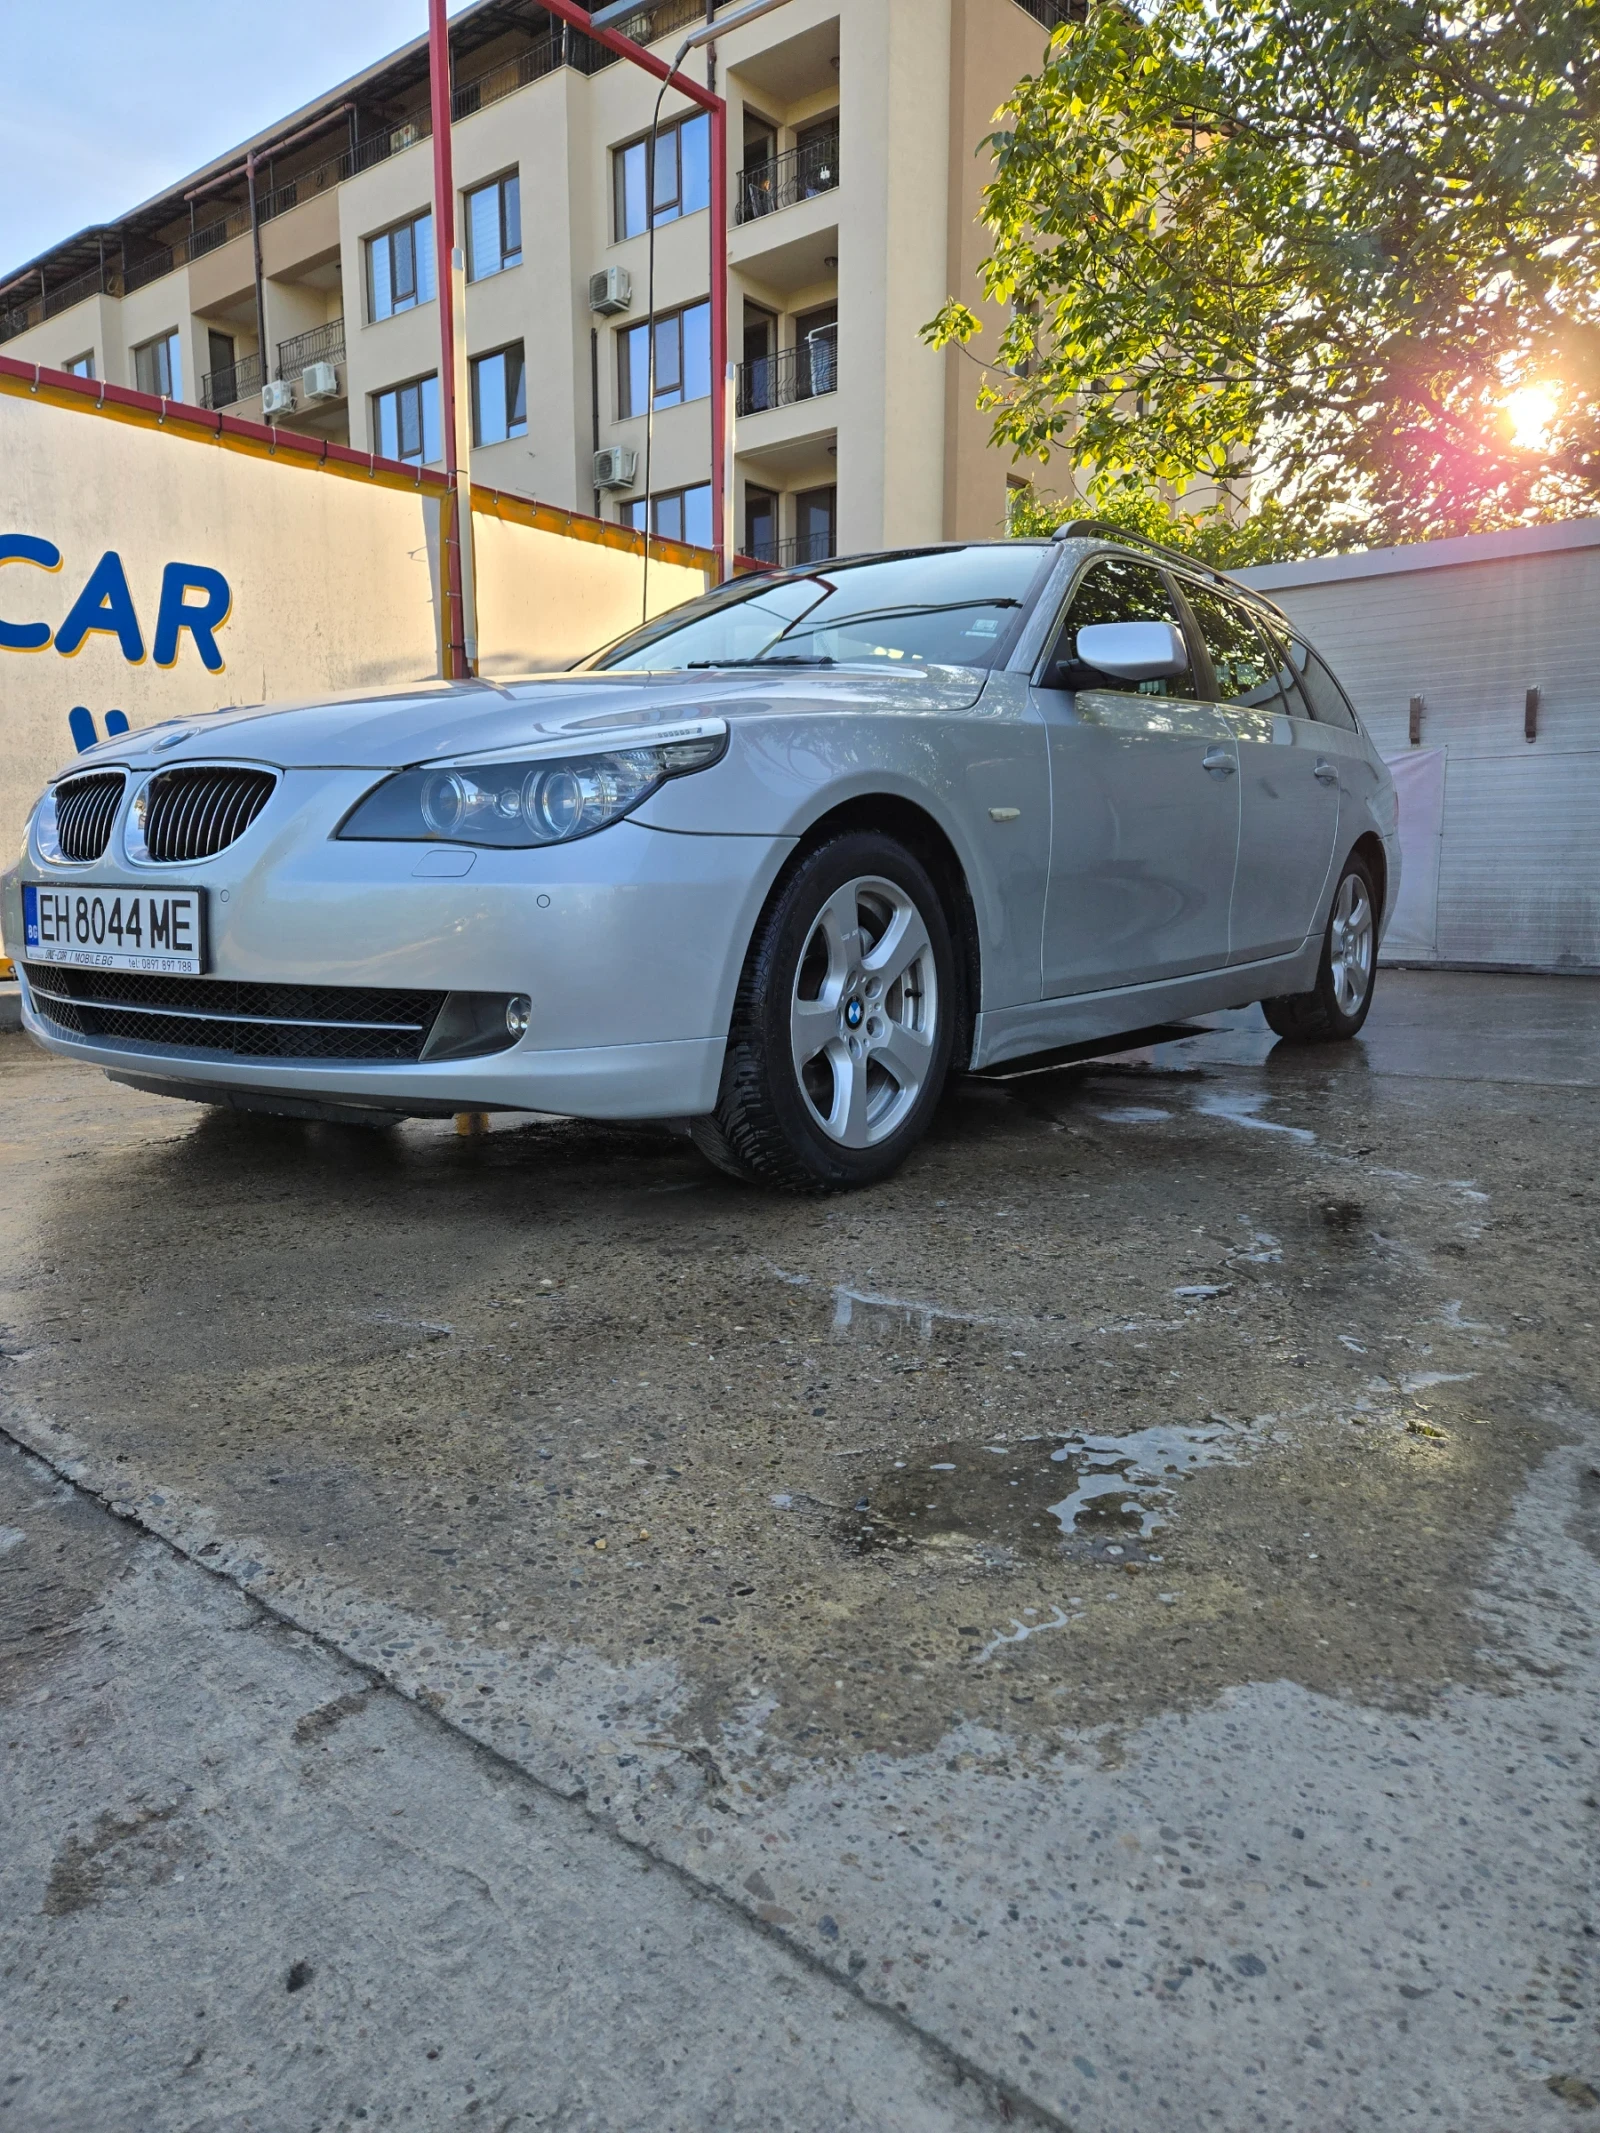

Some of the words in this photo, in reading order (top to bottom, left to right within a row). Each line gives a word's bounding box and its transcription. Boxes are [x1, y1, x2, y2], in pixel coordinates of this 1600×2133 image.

[0, 533, 233, 675] CAR
[27, 924, 38, 939] BG
[75, 896, 142, 947] 8044
